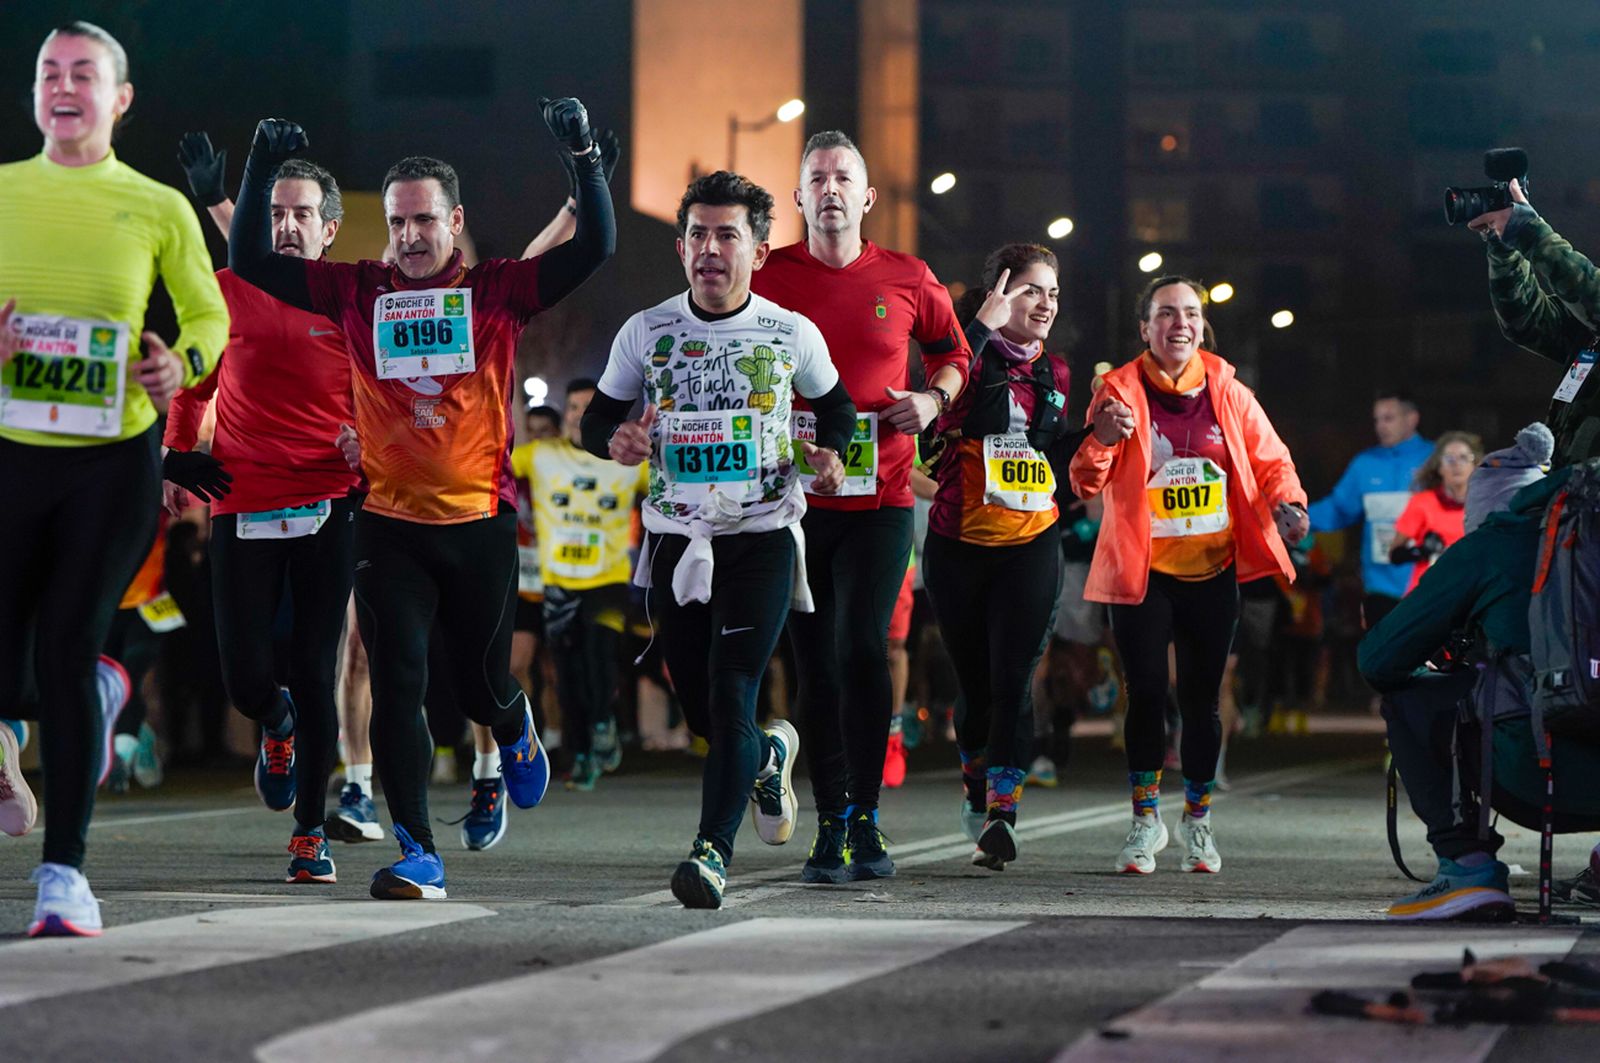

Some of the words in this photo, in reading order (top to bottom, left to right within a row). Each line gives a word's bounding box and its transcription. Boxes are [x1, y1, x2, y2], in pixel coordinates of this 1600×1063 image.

[394, 298, 422, 309] NOCHE
[424, 297, 435, 307] DE
[384, 310, 402, 322] SAN
[404, 307, 436, 320] ANTÓN
[26, 326, 60, 337] NOCHE
[393, 318, 453, 348] 8196
[692, 346, 743, 375] can't
[13, 353, 106, 394] 12420
[680, 369, 735, 401] touch
[707, 393, 744, 412] me
[414, 409, 434, 417] SAN
[681, 422, 710, 432] NOCHE
[711, 421, 723, 431] DE
[797, 430, 815, 440] SAN
[672, 433, 689, 444] SAN
[690, 432, 724, 444] ANTÓN
[675, 443, 748, 474] 13129
[993, 450, 1010, 459] SAN
[1002, 460, 1046, 485] 6016
[1162, 485, 1211, 511] 6017
